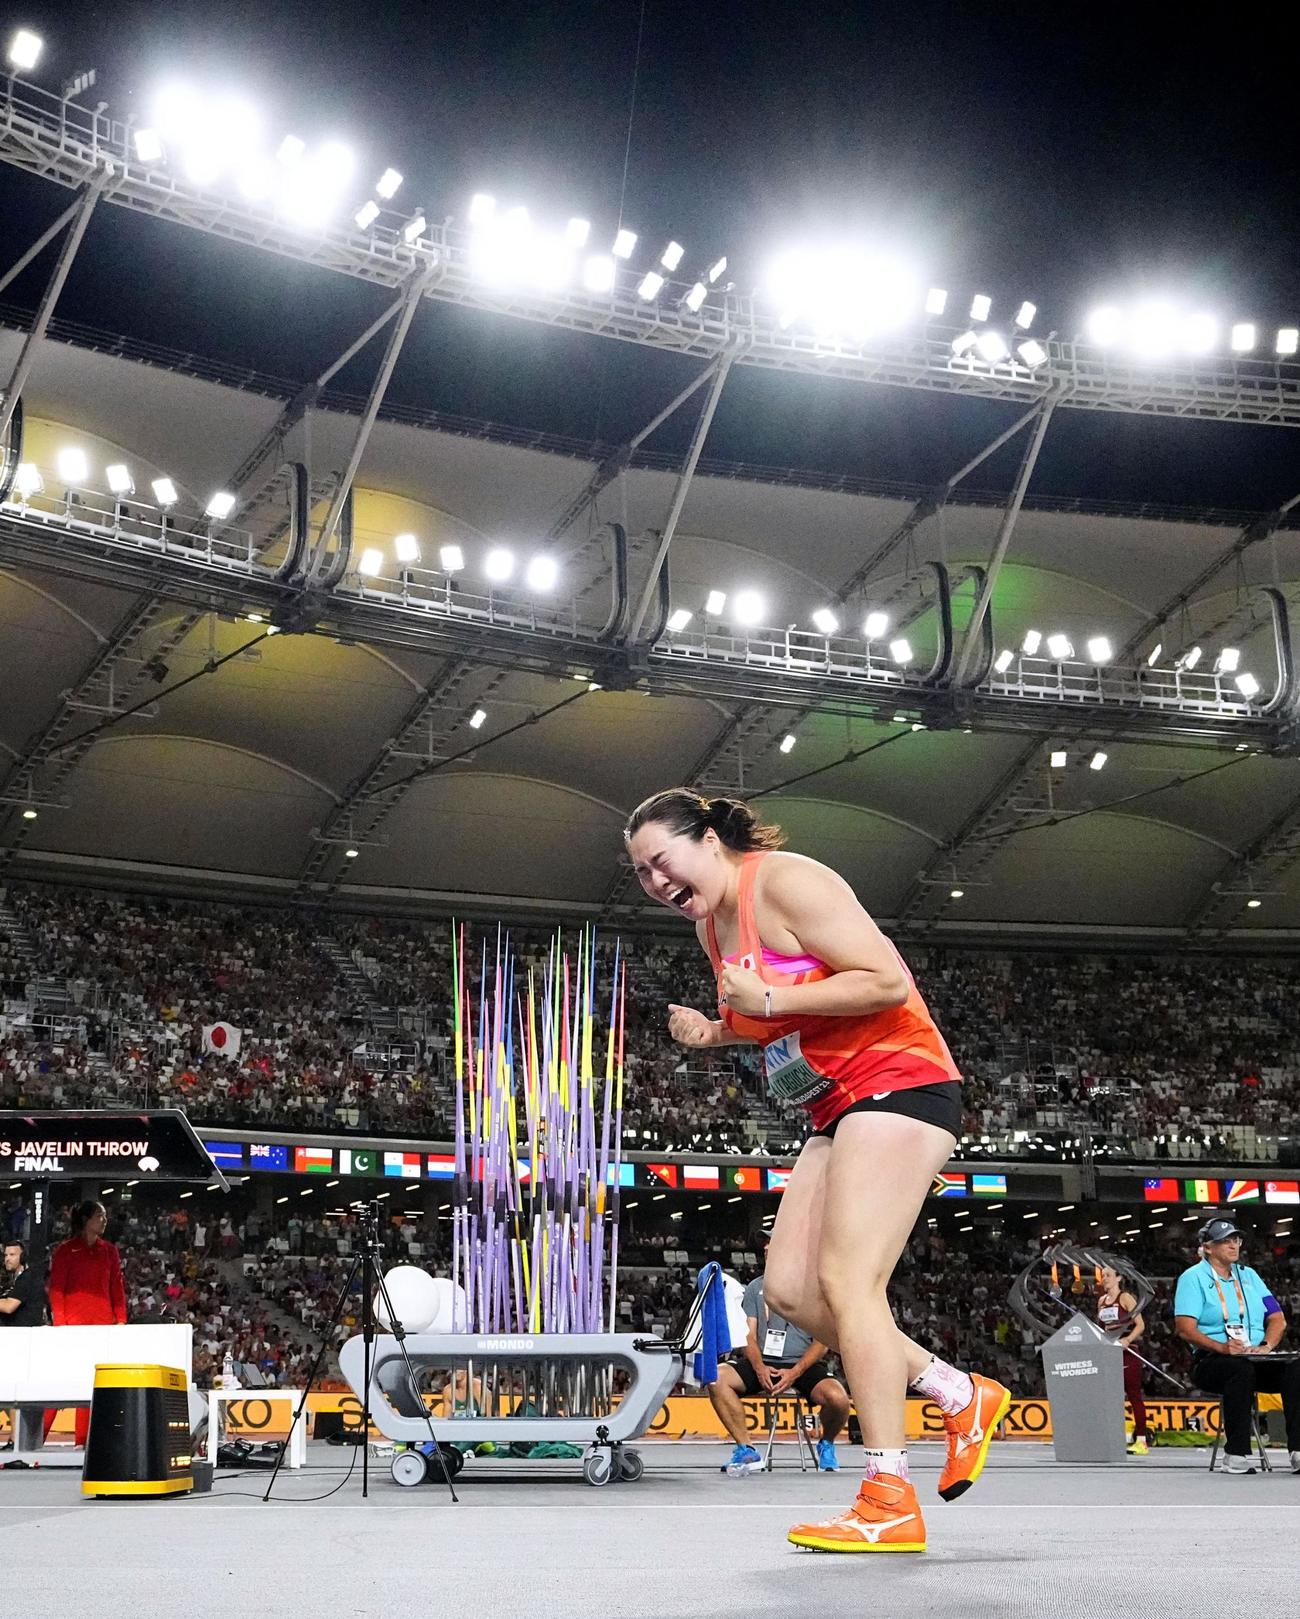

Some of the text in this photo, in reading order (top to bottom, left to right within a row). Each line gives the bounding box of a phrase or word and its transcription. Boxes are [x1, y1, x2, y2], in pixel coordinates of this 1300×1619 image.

[15, 1142, 83, 1156] JAVELIN
[87, 1142, 149, 1156] THROW
[14, 1157, 64, 1172] FINAL
[486, 1339, 535, 1350] MONDO
[1055, 1360, 1093, 1371] WITNESS
[1060, 1366, 1098, 1378] WONDER
[921, 1402, 1048, 1432] SKO
[805, 1418, 814, 1431] 5
[1188, 1420, 1198, 1432] 3
